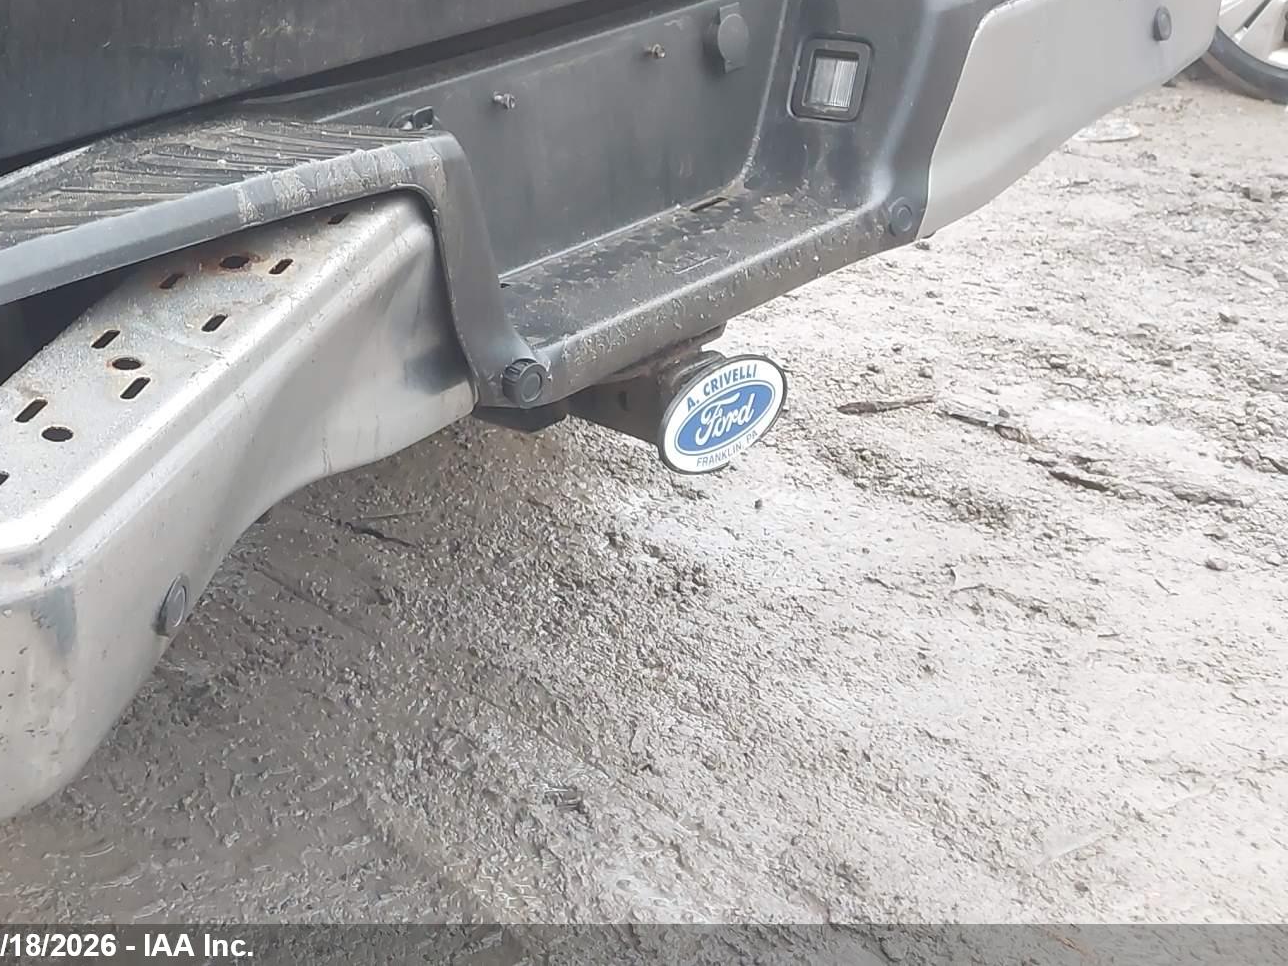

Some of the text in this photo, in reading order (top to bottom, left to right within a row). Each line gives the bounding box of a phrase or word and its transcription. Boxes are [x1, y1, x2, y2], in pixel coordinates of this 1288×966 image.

[686, 364, 757, 412] A. CRIVELLI
[695, 392, 754, 446] Ford
[745, 430, 758, 444] PA
